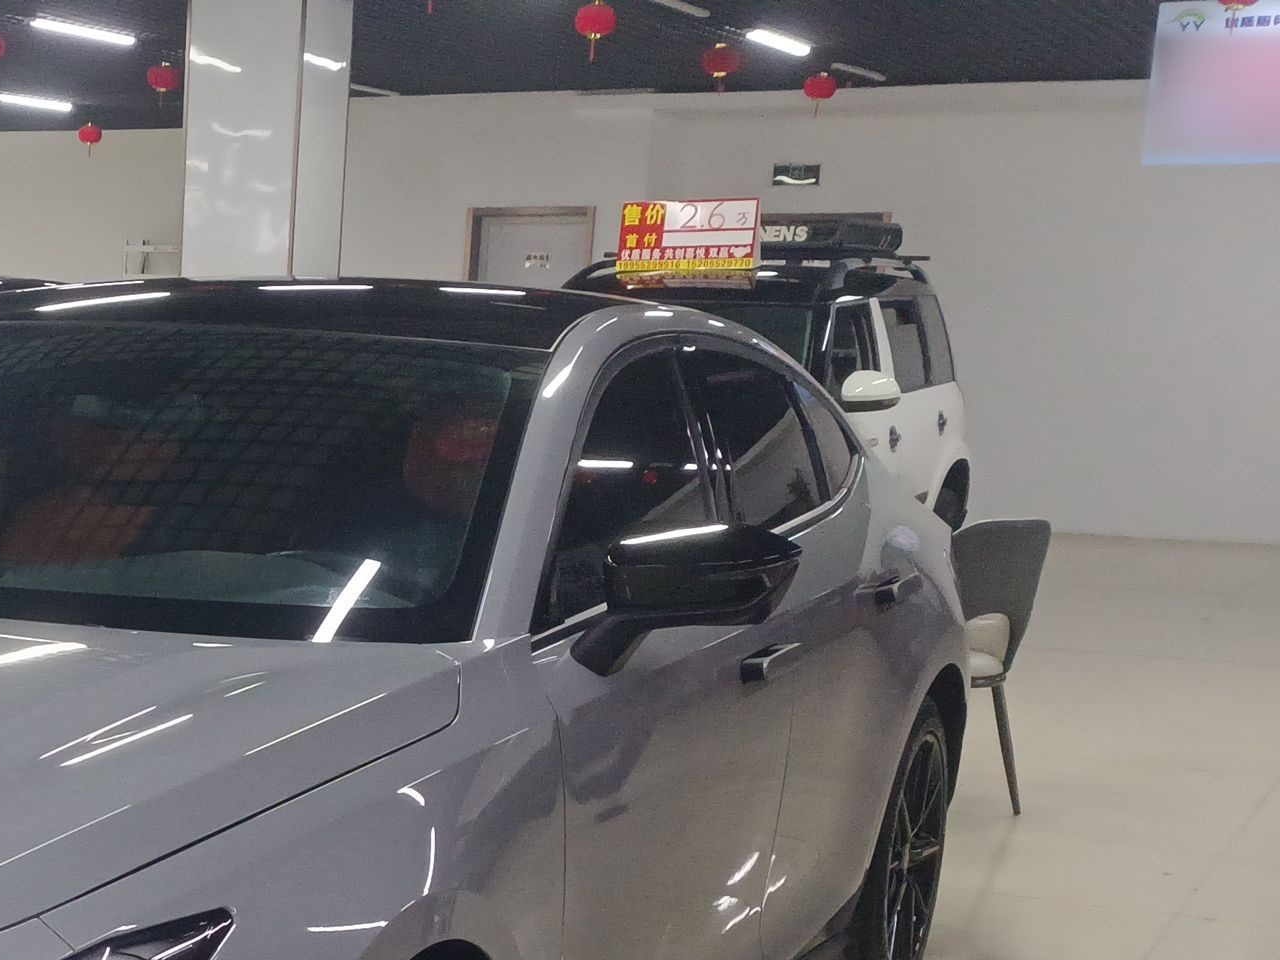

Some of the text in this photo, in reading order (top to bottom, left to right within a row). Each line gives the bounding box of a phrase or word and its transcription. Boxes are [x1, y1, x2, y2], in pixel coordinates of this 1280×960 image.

[623, 204, 665, 226] 售价
[680, 201, 725, 229] 2.6
[625, 232, 658, 248] 首付
[620, 248, 662, 261] 优质服务
